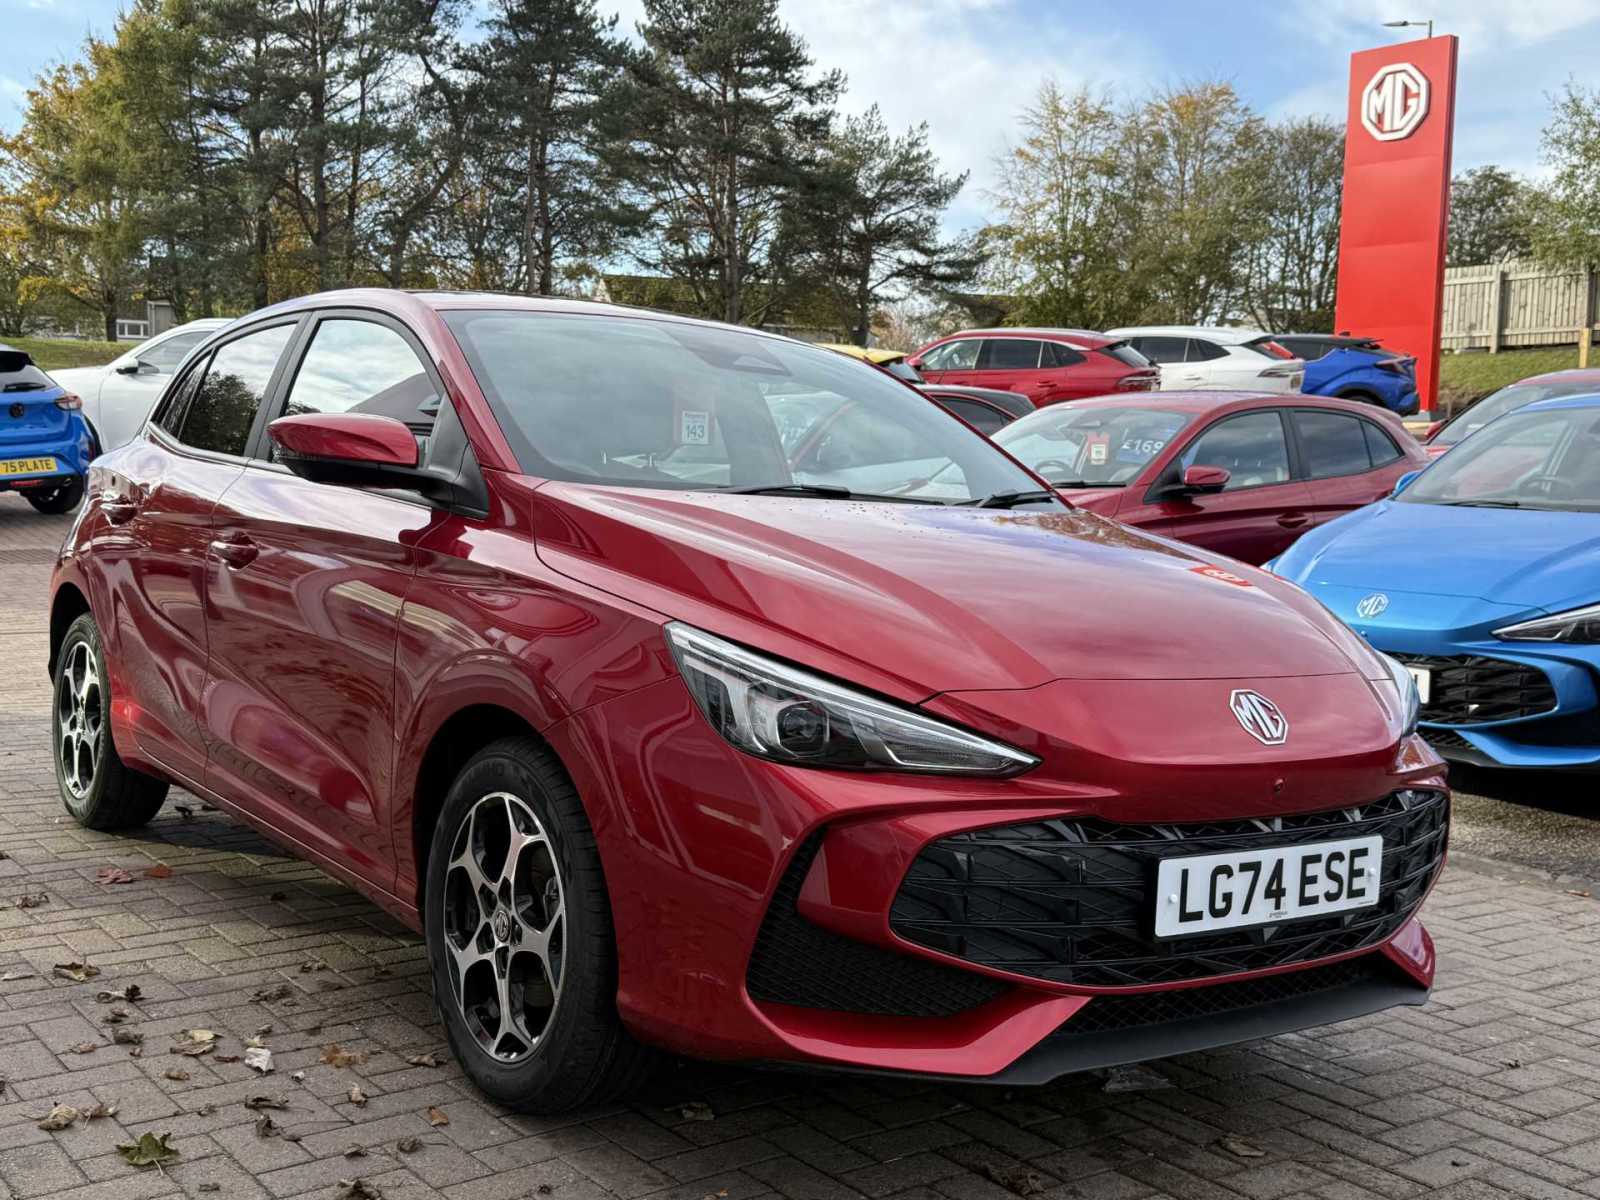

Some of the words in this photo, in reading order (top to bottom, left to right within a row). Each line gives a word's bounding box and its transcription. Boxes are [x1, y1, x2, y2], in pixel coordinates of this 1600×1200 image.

[1366, 69, 1422, 133] MG
[686, 425, 705, 439] 143
[1120, 439, 1165, 455] £169
[2, 462, 17, 472] 75
[17, 459, 52, 472] PLATE
[1358, 594, 1387, 616] MG
[1233, 692, 1285, 740] MG
[1178, 858, 1287, 923] LG74
[1298, 847, 1369, 907] ESE
